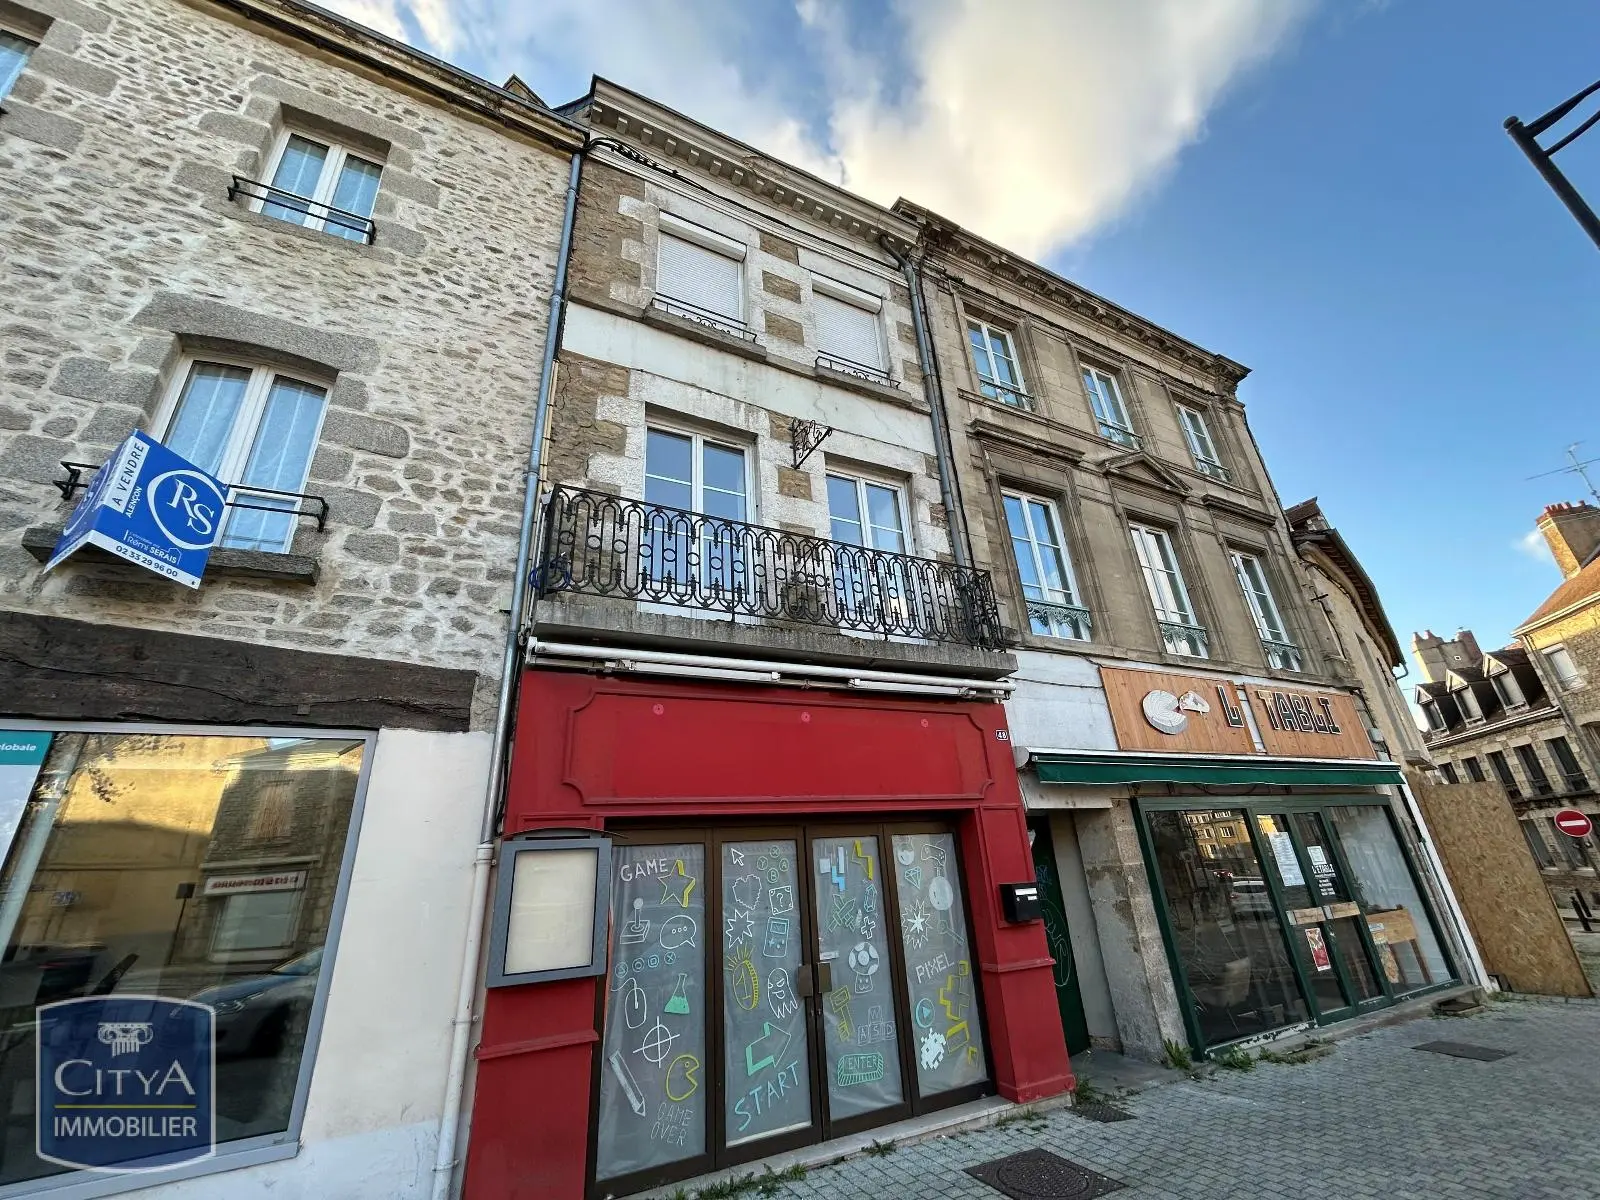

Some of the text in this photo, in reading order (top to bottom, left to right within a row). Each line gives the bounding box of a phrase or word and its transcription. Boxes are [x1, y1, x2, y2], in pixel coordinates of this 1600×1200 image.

[117, 442, 145, 491] VENDRE
[124, 485, 143, 518] ALENÇON
[166, 478, 215, 535] RS
[116, 546, 128, 556] 02
[129, 551, 141, 561] 33
[141, 557, 153, 566] 29
[166, 568, 178, 577] 00
[149, 546, 177, 564] SERAIS
[0, 743, 37, 751] lobale
[620, 858, 668, 882] GAME
[915, 952, 955, 984] PIXEL
[848, 1055, 878, 1070] ENTER
[734, 1060, 799, 1132] START
[657, 1102, 694, 1127] GAME
[650, 1121, 687, 1146] OVER
